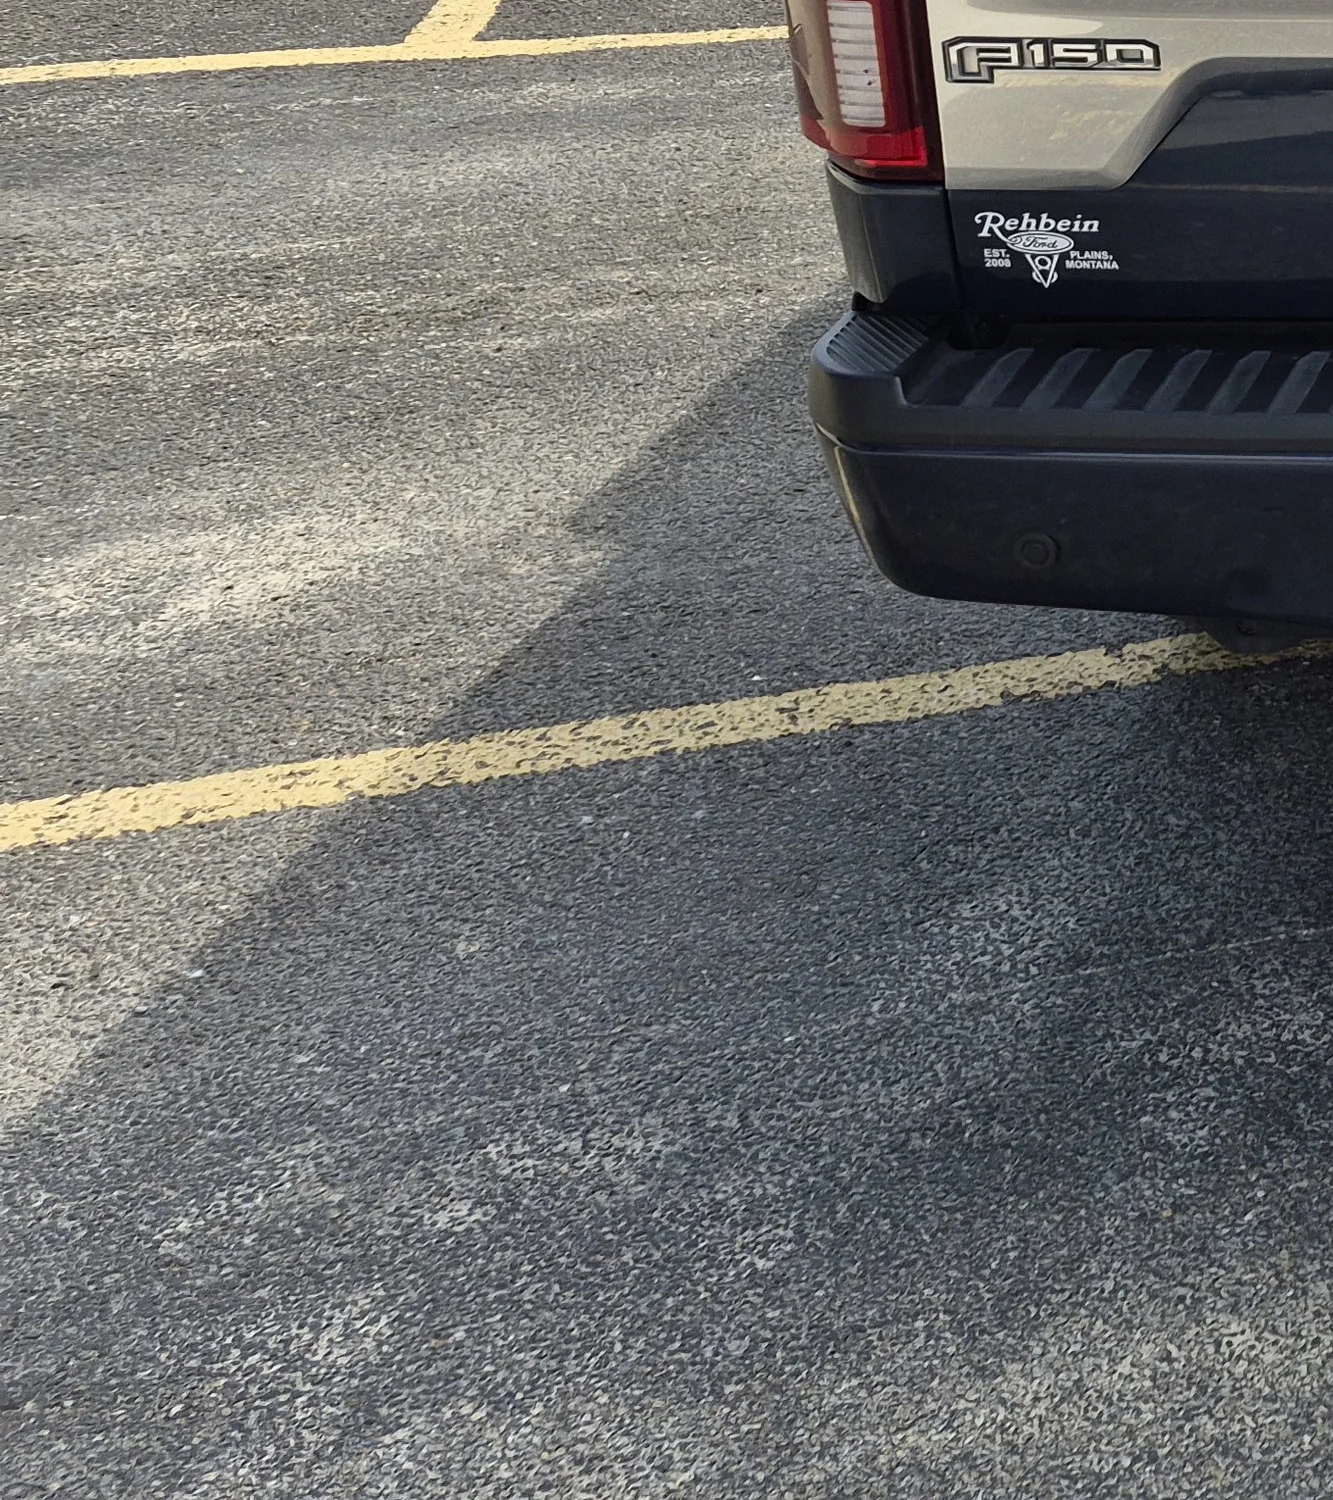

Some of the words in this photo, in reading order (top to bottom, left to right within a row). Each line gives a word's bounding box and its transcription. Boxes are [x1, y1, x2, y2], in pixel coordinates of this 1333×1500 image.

[974, 211, 1100, 237] Rehbein
[1022, 236, 1059, 249] Ford
[984, 248, 1010, 258] EST.
[1070, 251, 1113, 261] PLAINS,
[1065, 260, 1119, 270] MONTANA
